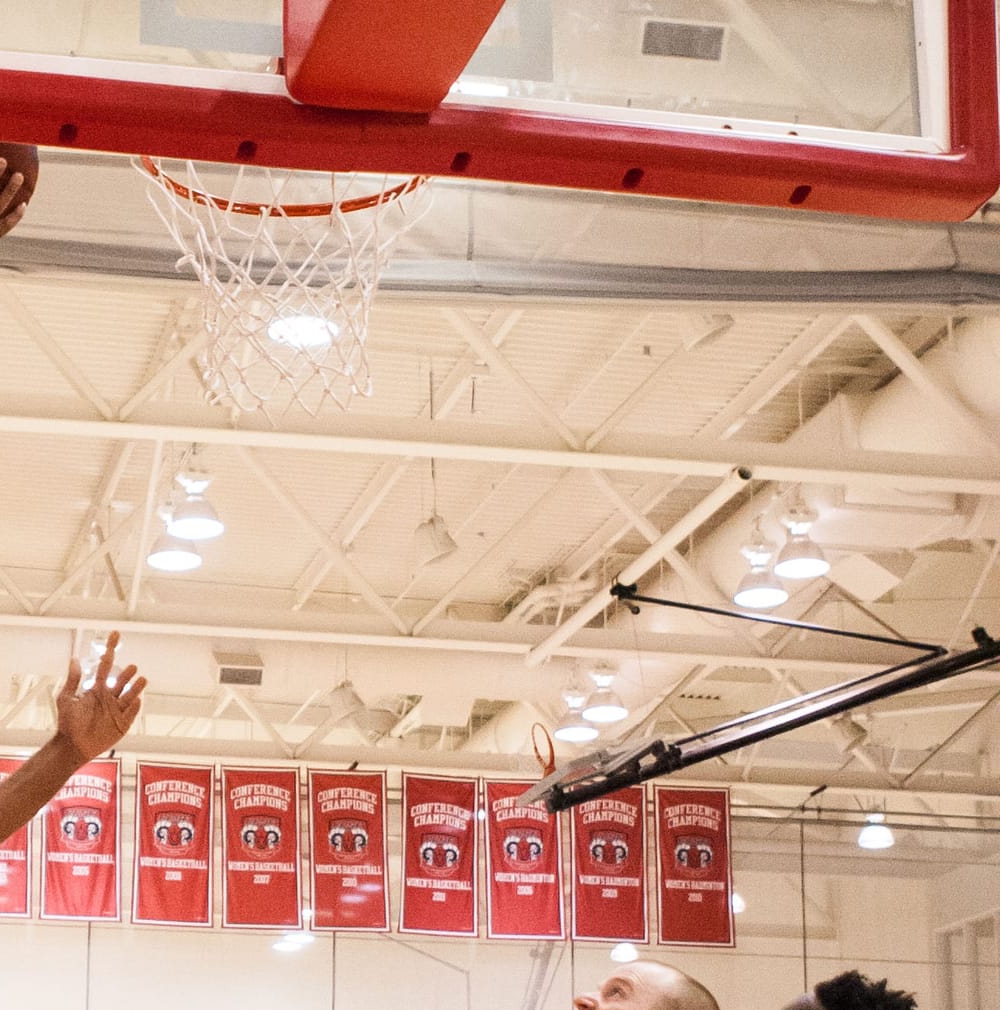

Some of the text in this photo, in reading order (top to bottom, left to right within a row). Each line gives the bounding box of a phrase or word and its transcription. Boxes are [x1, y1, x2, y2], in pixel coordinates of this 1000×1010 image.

[145, 780, 205, 799] CONFERENCE
[230, 784, 291, 802] CONFERENCE
[317, 787, 377, 805] CONFERENCE
[148, 791, 202, 809] CHAMPIONS
[233, 795, 288, 812] CHAMPIONS
[321, 799, 375, 815] CHAMPIONS
[579, 799, 637, 818] CONFERENCE
[410, 802, 471, 820] CONFERENCE
[496, 807, 549, 824] CHAMPIONS
[582, 810, 635, 827] CHAMPIONS
[664, 804, 722, 822] CONFERENCE
[414, 813, 467, 831] CHAMPIONS
[668, 814, 719, 832] CHAMPIONS
[166, 858, 207, 870] BASKETBALL
[255, 862, 295, 873] BASKETBALL
[341, 865, 382, 876] BASKETBALL
[432, 879, 472, 891] BASKETBALL
